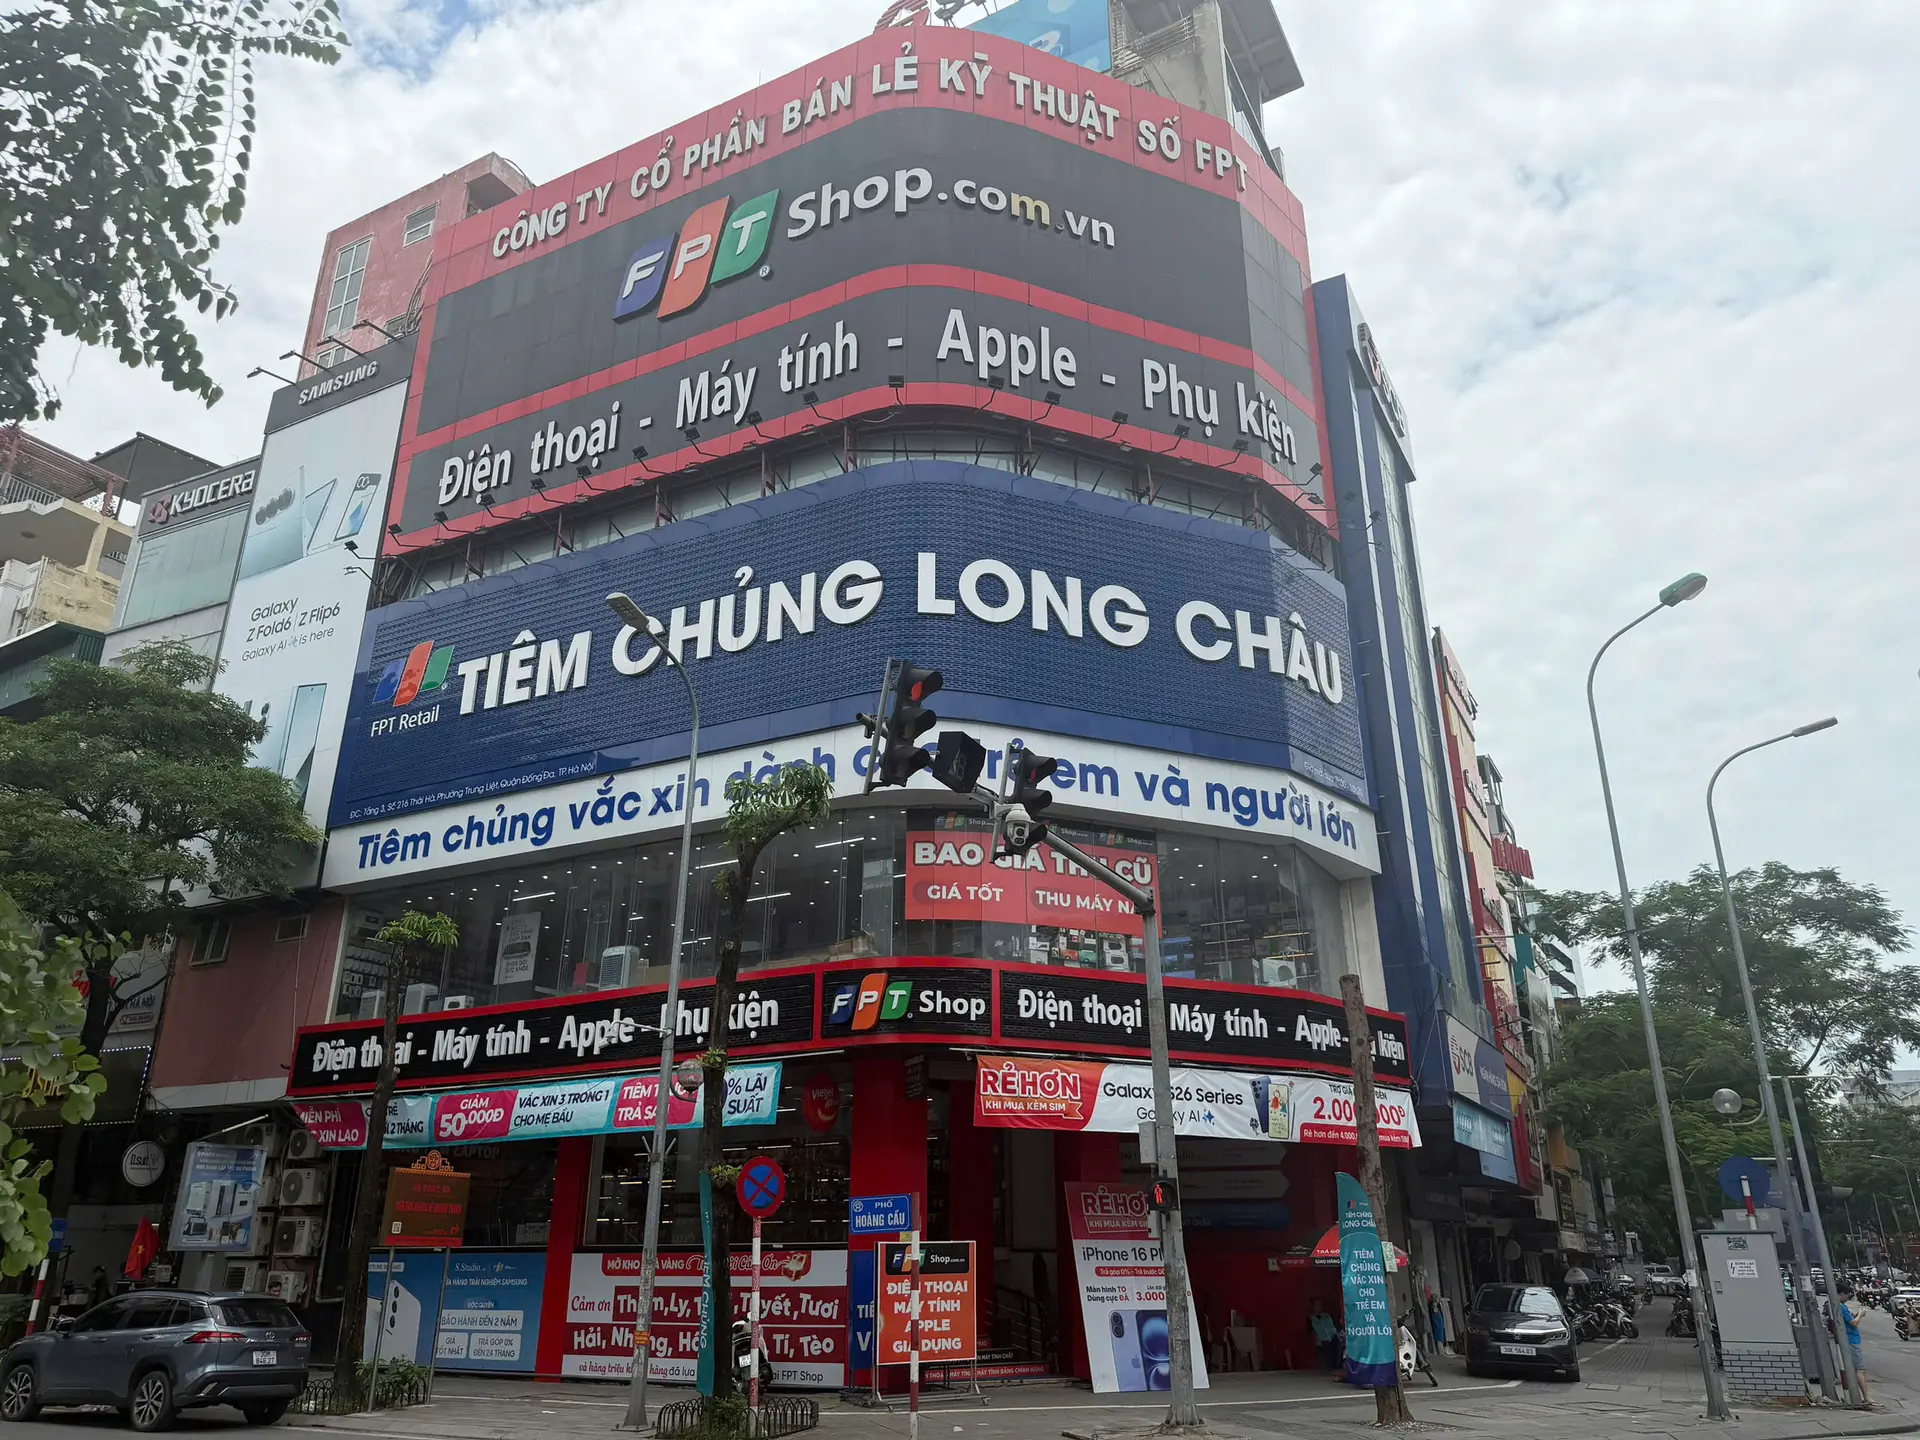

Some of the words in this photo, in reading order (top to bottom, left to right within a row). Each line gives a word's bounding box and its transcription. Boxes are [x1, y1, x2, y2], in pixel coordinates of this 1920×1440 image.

[492, 202, 568, 259] CÔNG
[576, 181, 613, 224] TY
[631, 135, 675, 198] CỔ
[683, 109, 766, 178] PHẦN
[782, 75, 852, 135] BÁN
[872, 42, 919, 95] LẺ
[939, 51, 993, 96] KỸ
[1009, 72, 1120, 142] THUẬT
[1138, 116, 1181, 160] SỐ
[1195, 138, 1248, 192] FPT
[298, 360, 378, 406] SAMSUNG
[438, 443, 513, 505] Điện
[530, 401, 621, 475] thoại
[675, 359, 758, 429] Máy
[778, 320, 859, 394] tính
[936, 308, 1078, 387] Apple
[1142, 358, 1219, 438] Phụ
[1236, 381, 1297, 466] kiện
[169, 469, 256, 516] KYOCERA
[251, 596, 299, 623] Galaxy
[246, 628, 256, 642] Z
[257, 616, 292, 640] Fold6
[298, 612, 308, 627] Z
[309, 602, 341, 626] Flip6
[458, 629, 593, 716] TIÊM
[612, 560, 885, 677] CHỦNG
[917, 552, 1151, 648] LONG
[1175, 600, 1343, 704] CHÂU
[241, 643, 276, 662] Galaxy
[277, 641, 288, 652] AI
[298, 633, 308, 645] is
[309, 626, 334, 643] here
[370, 716, 397, 738] FPT
[399, 704, 441, 731] Retail
[358, 828, 431, 869] Tiêm
[442, 803, 556, 852] chủng
[569, 774, 642, 830] vắc
[647, 774, 710, 817] xin
[1049, 757, 1119, 797] em
[1134, 764, 1190, 807] và
[1205, 781, 1313, 831] người
[1317, 800, 1358, 850] lớn
[913, 841, 984, 867] BAO
[1114, 856, 1153, 885] CŨ
[927, 882, 962, 900] GIÁ
[966, 883, 1003, 902] TỐT
[1035, 889, 1071, 907] THU
[1076, 894, 1114, 912] MÁY
[919, 990, 986, 1021] Shop
[1017, 988, 1073, 1028] Điện
[1082, 994, 1142, 1033] thoại
[1170, 1003, 1215, 1041] Máy
[1223, 1007, 1268, 1038] tính
[1295, 1015, 1340, 1051] Apple
[1377, 1030, 1405, 1066] kiện
[312, 1038, 357, 1081] Điện
[360, 1031, 414, 1074] thại
[432, 1027, 480, 1069] Máy
[486, 1020, 531, 1057] tính
[558, 1008, 635, 1057] Apple
[1459, 1046, 1474, 1077] SCB
[744, 1073, 768, 1092] LÃI
[980, 1061, 1018, 1097] RẺ
[1019, 1069, 1081, 1100] HƠN
[519, 1092, 538, 1108] VẮC
[541, 1094, 558, 1108] XIN
[558, 1093, 566, 1106] 3
[567, 1090, 604, 1105] TRONG
[623, 1081, 653, 1100] TIÊM
[1103, 1082, 1155, 1099] Galax
[1170, 1086, 1192, 1101] S26
[1196, 1088, 1244, 1105] Series
[460, 1094, 490, 1110] GIẢM
[727, 1093, 764, 1115] SUẤT
[985, 1100, 1001, 1109] KHI
[1003, 1101, 1025, 1110] MUA
[1026, 1099, 1048, 1111] KÈM
[1049, 1102, 1066, 1111] SIM
[324, 1107, 342, 1123] PHÍ
[514, 1113, 536, 1127] CHO
[535, 1111, 552, 1128] MẸ
[552, 1107, 574, 1123] BẦU
[617, 1101, 642, 1122] TRẢ
[318, 1129, 336, 1143] XIN
[338, 1128, 359, 1142] LAO
[396, 1121, 424, 1134] THÁNG
[874, 1198, 893, 1209] PHỐ
[1081, 1185, 1110, 1216] RẺ
[855, 1212, 885, 1228] HOÀNG
[887, 1211, 906, 1226] CẦU
[1089, 1219, 1103, 1228] KHI
[1103, 1218, 1121, 1228] MUA
[1122, 1217, 1138, 1228] KÈM
[1342, 1219, 1360, 1229] LONG
[1082, 1246, 1129, 1261] iPhone
[1131, 1247, 1147, 1261] 16
[1353, 1248, 1374, 1259] TIÊM
[607, 1258, 622, 1270] MỞ
[622, 1259, 640, 1270] KHO
[661, 1258, 685, 1270] VÀNG
[1350, 1260, 1380, 1272] CHỦNG
[501, 1277, 528, 1286] SAMSUNG
[924, 1280, 968, 1295] THOẠI
[1368, 1275, 1384, 1284] XIN
[1086, 1285, 1101, 1293] Màn
[1102, 1285, 1116, 1293] hình
[1359, 1287, 1375, 1297] CHO
[571, 1295, 595, 1312] Cảm
[799, 1292, 840, 1320] Tươi
[927, 1297, 961, 1312] TÍNH
[1087, 1294, 1105, 1303] Dùng
[1355, 1298, 1370, 1311] TRẺ
[1371, 1300, 1386, 1310] EM
[441, 1314, 457, 1326] BẢO
[458, 1314, 477, 1326] HÀNH
[478, 1313, 493, 1327] ĐẾN
[500, 1315, 517, 1327] NĂM
[1364, 1311, 1376, 1322] VÀ
[904, 1319, 950, 1333] APPLE
[573, 1327, 606, 1350] Hải,
[799, 1334, 834, 1357] Tèo
[921, 1337, 962, 1354] DỤNG
[448, 1346, 464, 1356] NHẤT
[494, 1347, 515, 1358] THÁNG
[588, 1361, 606, 1376] hàng
[607, 1362, 625, 1377] triệu
[649, 1363, 668, 1378] hàng
[668, 1366, 680, 1376] đã
[682, 1365, 695, 1379] lựa
[782, 1371, 798, 1381] FPT
[799, 1370, 824, 1384] Shop
